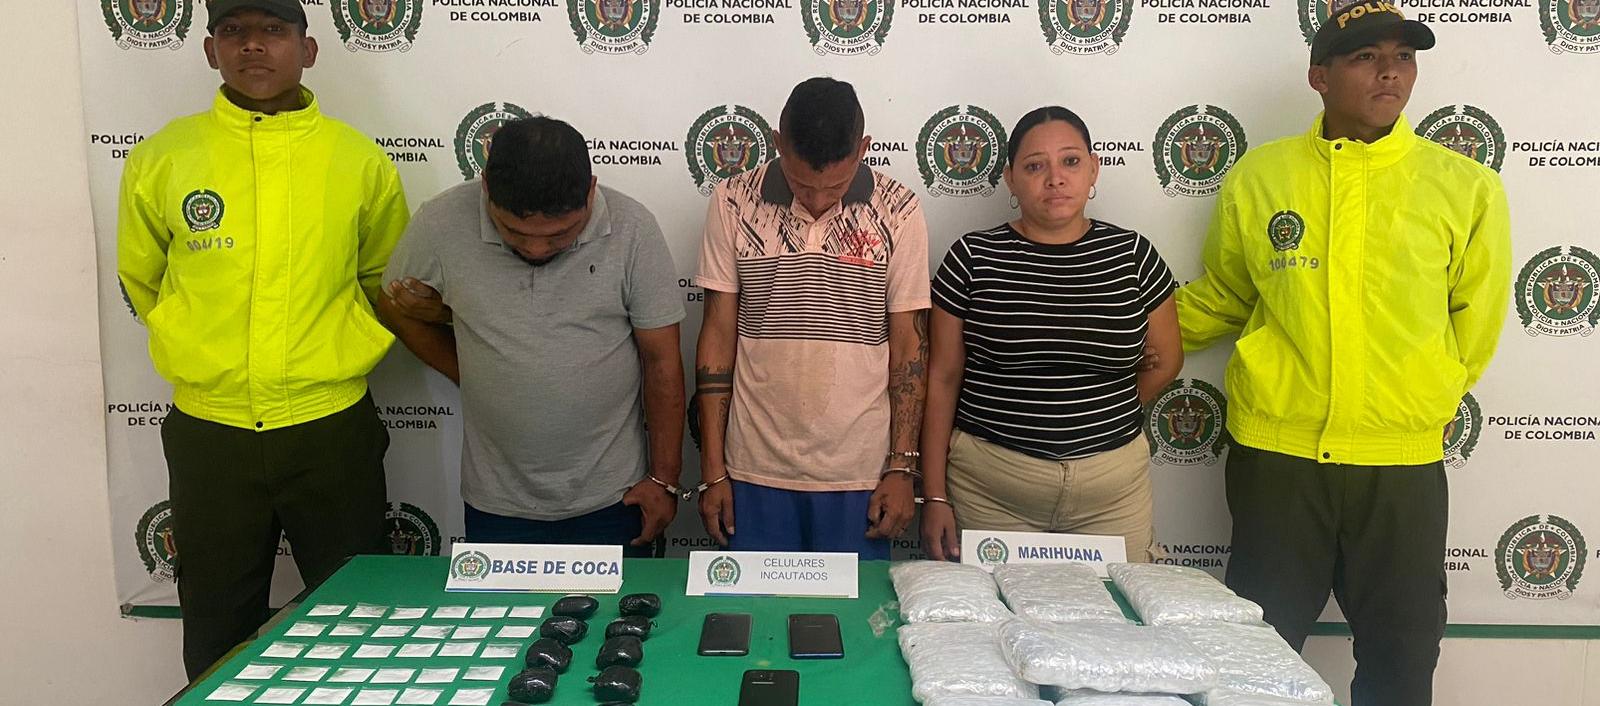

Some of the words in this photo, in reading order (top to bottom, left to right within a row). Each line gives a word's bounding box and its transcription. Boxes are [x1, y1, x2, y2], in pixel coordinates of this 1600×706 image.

[722, 0, 792, 8] NACIONAL
[957, 0, 1030, 8] NACIONAL
[1199, 0, 1271, 8] NACIONAL
[1458, 0, 1532, 8] NACIONAL
[450, 12, 468, 22] DE
[471, 12, 541, 22] COLOMBIA
[683, 14, 701, 24] DE
[704, 14, 775, 24] COLOMBIA
[918, 13, 936, 24] DE
[939, 13, 1011, 24] COLOMBIA
[1158, 13, 1176, 24] DE
[1179, 13, 1251, 24] COLOMBIA
[1337, 2, 1406, 29] POLIC
[1418, 13, 1435, 22] DE
[1440, 13, 1512, 22] COLOMBIA
[1425, 119, 1448, 140] BLICA
[375, 137, 445, 148] NACIONAL
[610, 141, 678, 151] NACIONAL
[868, 142, 908, 151] IONAL
[1092, 142, 1144, 151] CIONAL
[1512, 140, 1564, 151] POLICÍA
[1568, 142, 1600, 152] NACI
[112, 149, 129, 159] DE
[387, 152, 428, 162] OMBIA
[592, 155, 662, 165] COLOMBIA
[863, 156, 891, 166] MBIA
[1529, 157, 1546, 166] DE
[1549, 157, 1600, 166] COLOM
[687, 293, 703, 302] DE
[108, 401, 162, 413] POLICÍA
[386, 406, 454, 416] NACIONAL
[128, 417, 146, 426] DE
[381, 420, 437, 429] OLOMBIA
[1488, 415, 1540, 426] POLICÍA
[1504, 431, 1522, 440] DE
[1525, 431, 1595, 440] COLOMBIA
[1444, 437, 1467, 455] CIONAL
[893, 540, 921, 549] POLI
[1173, 545, 1231, 554] NACIONA
[1018, 546, 1103, 562] MARIHUANA
[1447, 548, 1488, 557] IONAL
[491, 560, 538, 574] BASE
[543, 561, 566, 574] DE
[571, 561, 619, 575] COCA
[764, 558, 825, 568] CELULARES
[1155, 558, 1223, 568] COLOMBIA
[160, 570, 172, 579] DIO
[760, 571, 829, 581] INCAUTADOS
